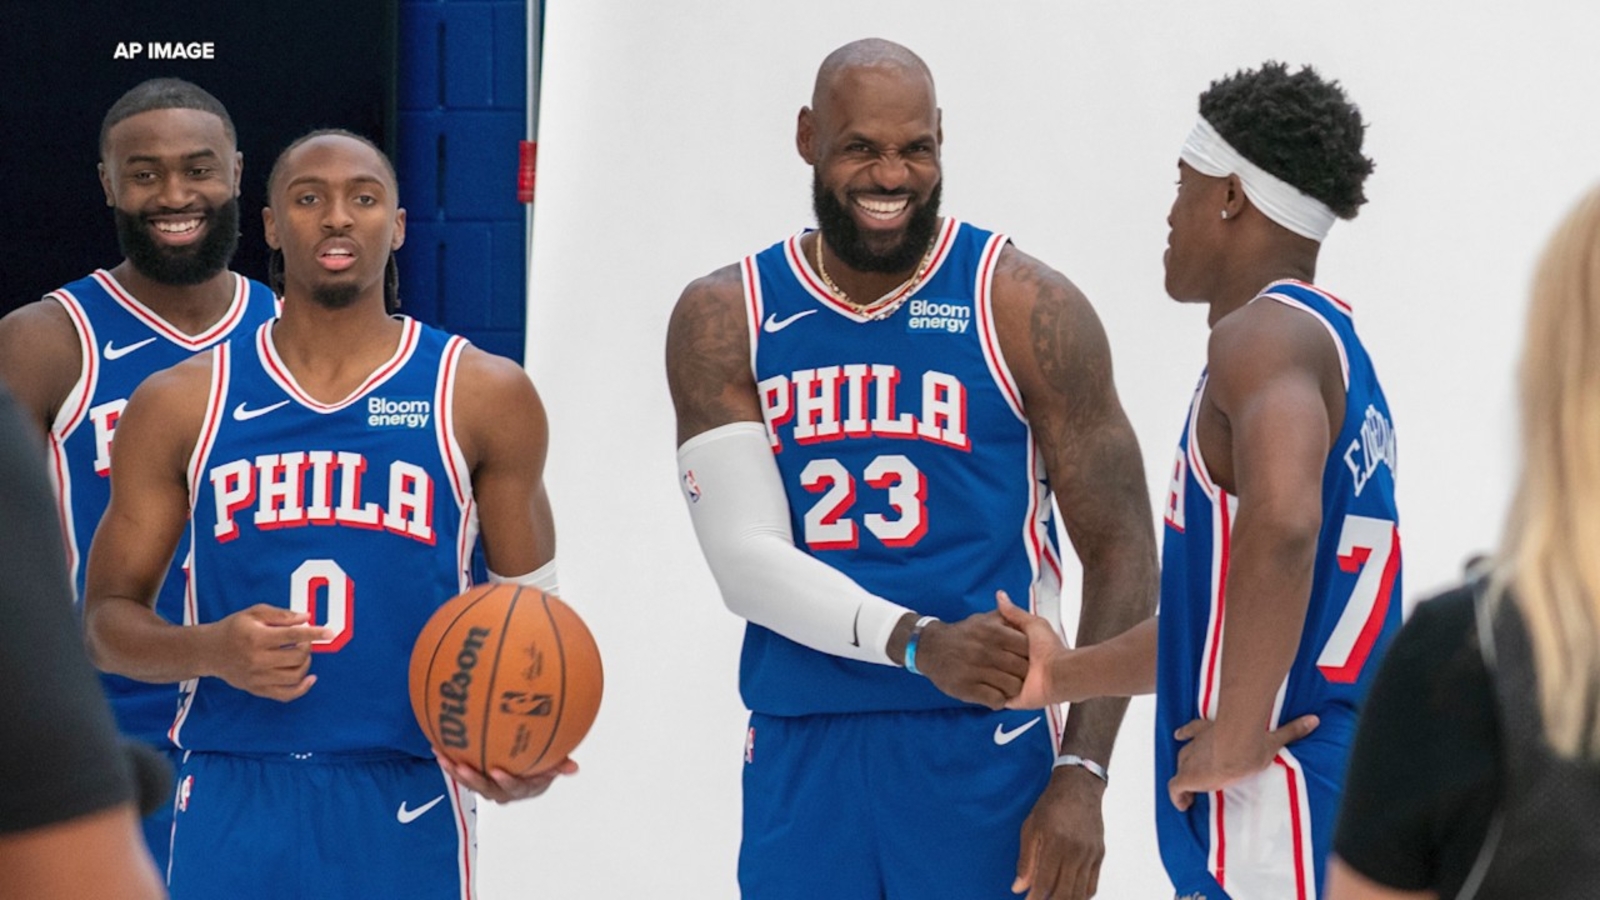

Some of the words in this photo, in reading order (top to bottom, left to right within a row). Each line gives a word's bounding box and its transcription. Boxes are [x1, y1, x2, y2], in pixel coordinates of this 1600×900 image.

[908, 317, 970, 333] energy
[909, 300, 970, 318] Bloom
[368, 397, 430, 414] Bloom
[368, 413, 430, 428] energy
[757, 364, 971, 453] PHILA
[209, 450, 436, 545] PHILA
[800, 455, 928, 550] 23
[290, 559, 354, 652] 0
[1316, 514, 1401, 684] 7
[438, 625, 491, 749] Wilson
